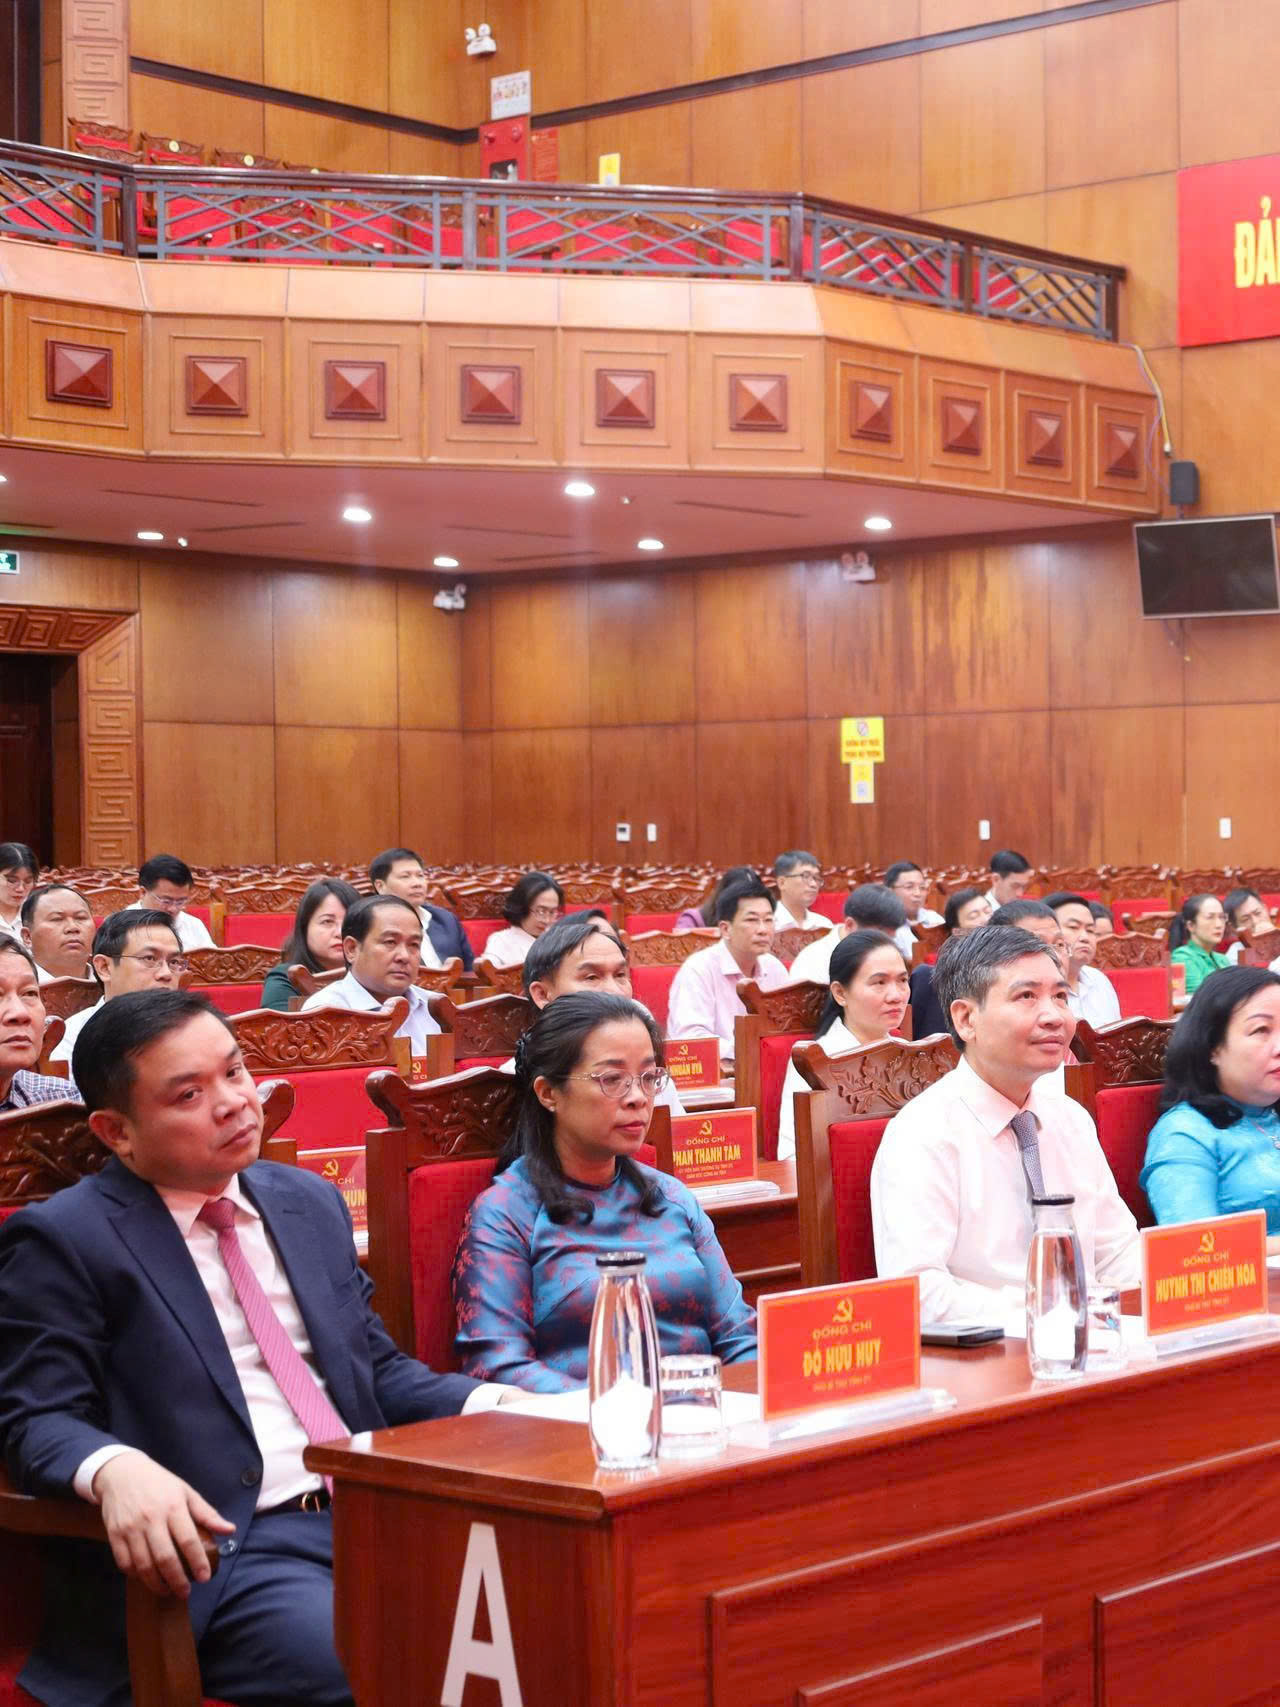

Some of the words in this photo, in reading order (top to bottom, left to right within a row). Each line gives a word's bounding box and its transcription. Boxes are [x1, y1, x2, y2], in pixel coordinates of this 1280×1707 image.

[686, 1136, 710, 1146] ĐỒNG
[711, 1134, 725, 1143] CHÍ
[695, 1145, 722, 1165] THANH
[337, 1176, 355, 1185] CHÍ
[343, 1186, 367, 1208] HÙN
[812, 1323, 849, 1341] ĐỒNG
[852, 1319, 872, 1333] CHÍ
[856, 1338, 881, 1368] HUY
[440, 1521, 524, 1707] A
